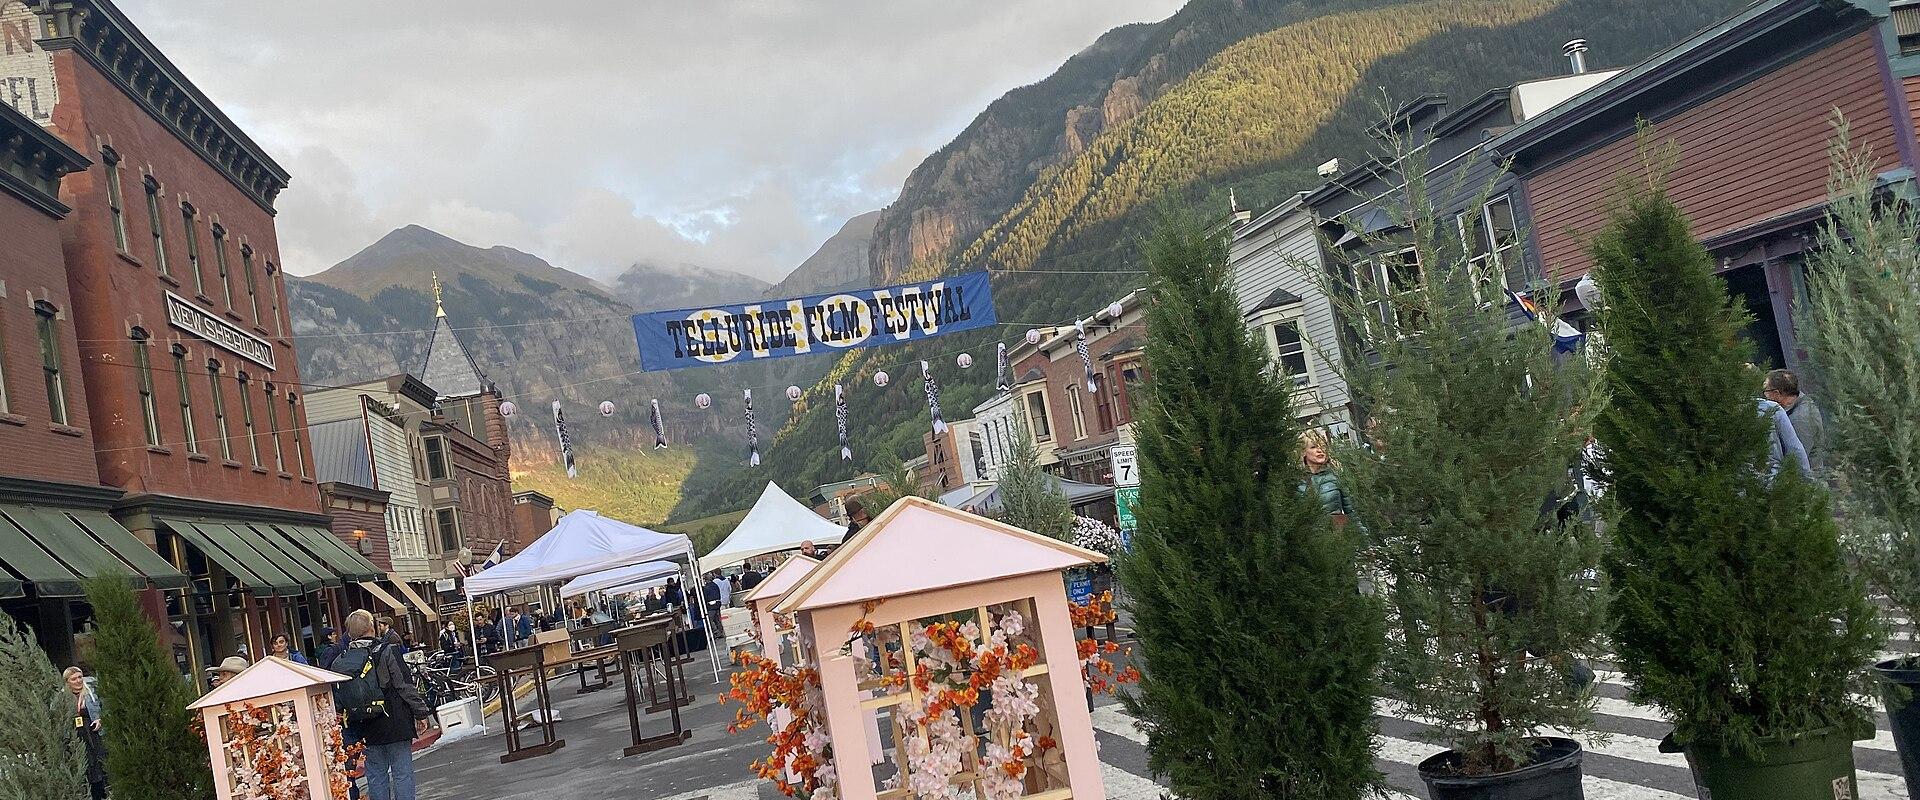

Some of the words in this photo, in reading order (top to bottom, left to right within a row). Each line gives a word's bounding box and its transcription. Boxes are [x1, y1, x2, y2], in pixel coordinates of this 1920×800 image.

[0, 77, 49, 119] EL
[168, 299, 202, 333] NEW
[204, 316, 272, 365] SHERIDAN
[666, 309, 797, 358] TELLURIDE
[803, 300, 862, 344] FILM
[865, 285, 971, 336] FESTIVAL
[1113, 450, 1135, 458] SPEED
[1116, 457, 1133, 465] LIMIT
[1120, 464, 1131, 481] 7
